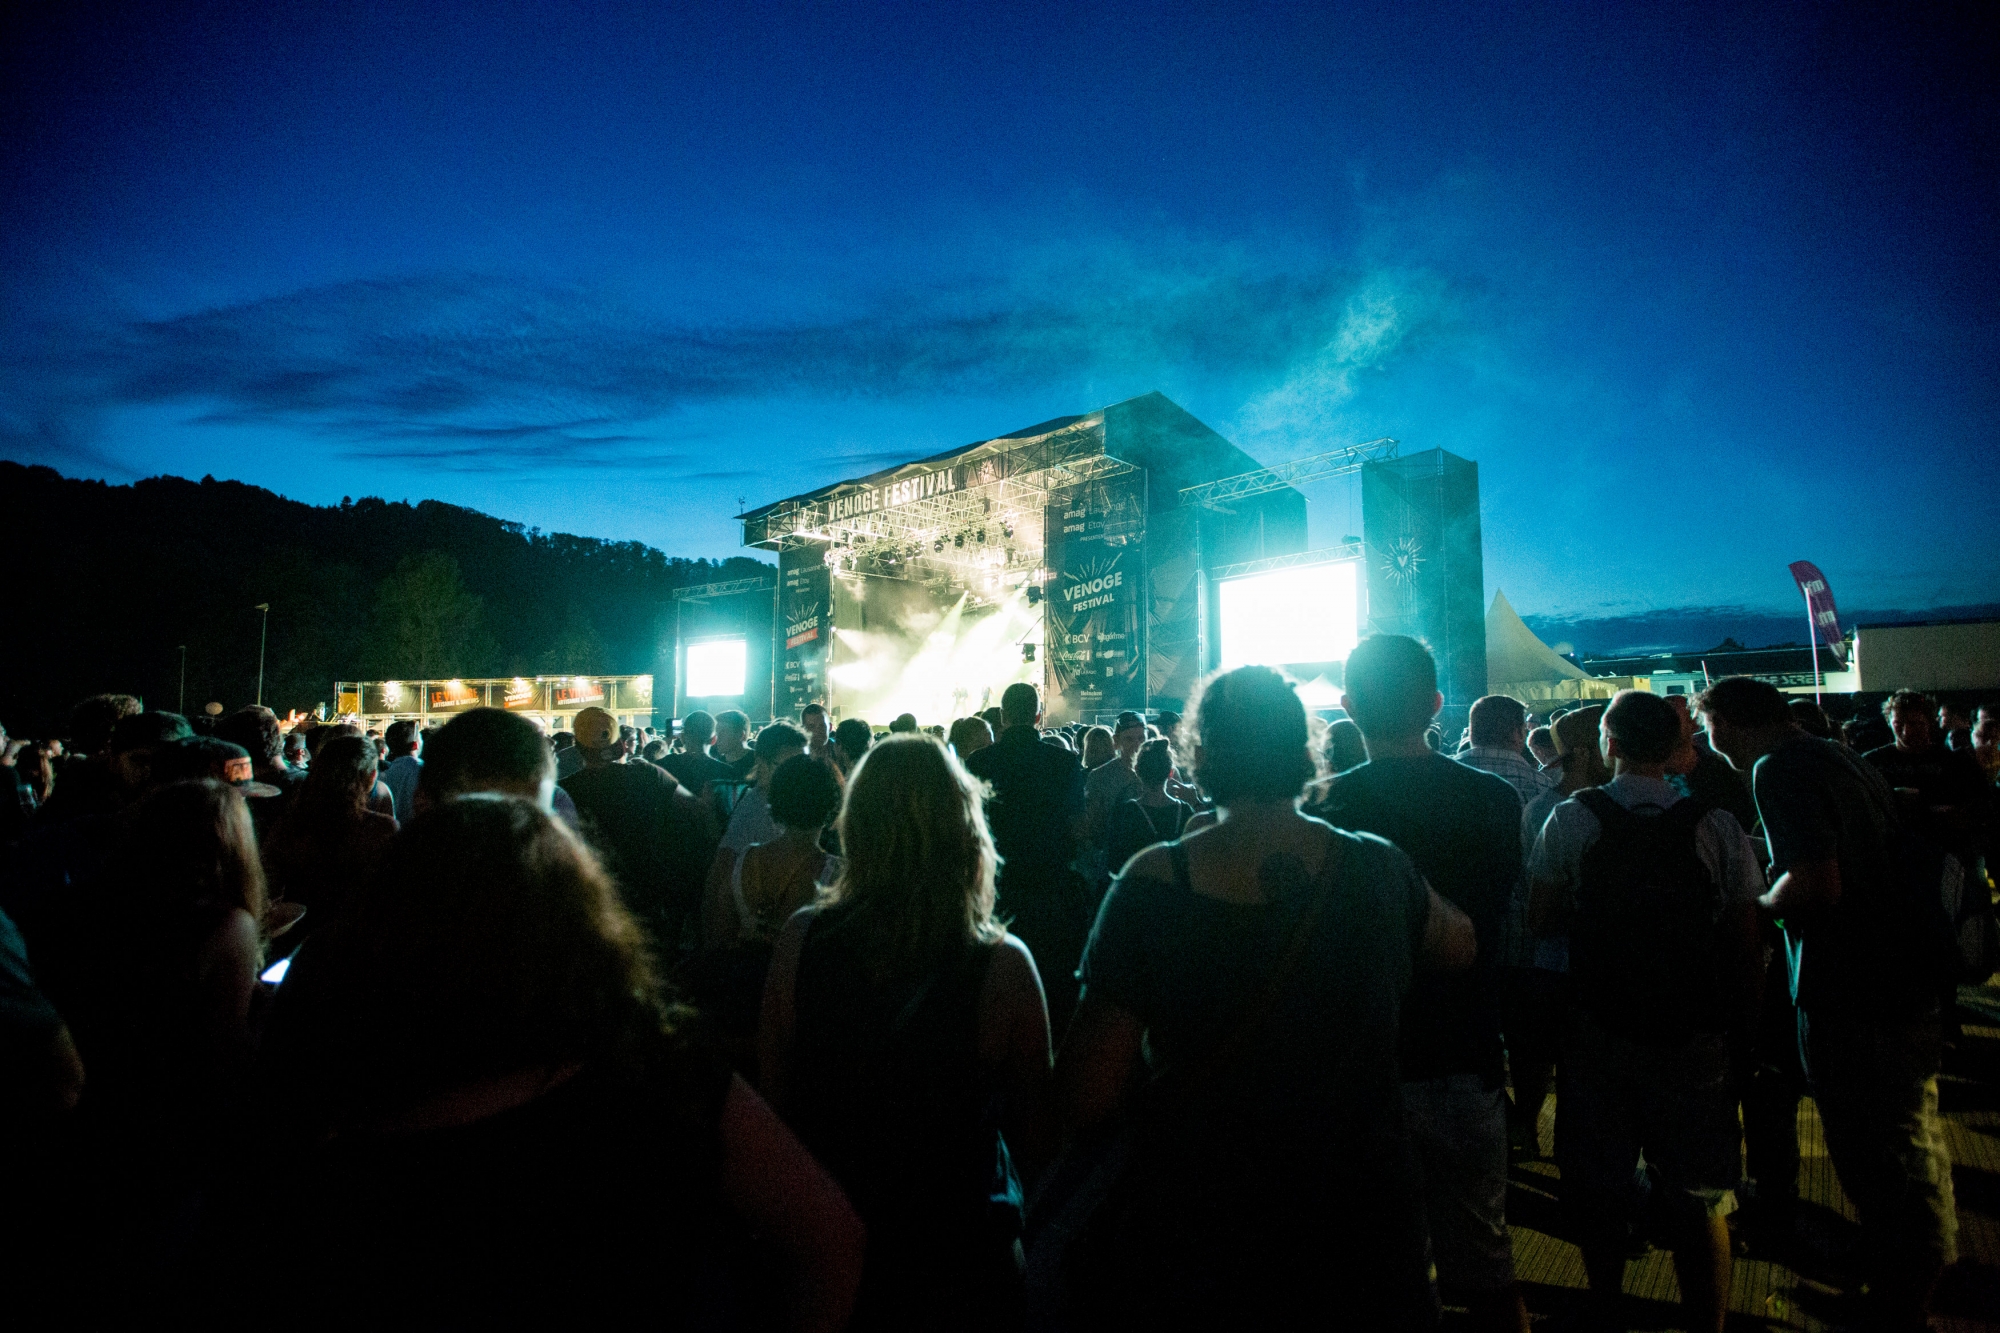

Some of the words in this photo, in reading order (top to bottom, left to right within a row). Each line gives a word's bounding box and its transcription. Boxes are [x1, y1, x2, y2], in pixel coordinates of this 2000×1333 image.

[827, 488, 880, 522] VENOGE
[884, 468, 956, 507] FESTIVAL
[1063, 507, 1086, 520] amag
[1063, 522, 1085, 534] amag
[1063, 571, 1123, 602] VENOGE
[1073, 593, 1115, 613] FESTIVAL
[786, 616, 818, 637] VENOGE
[1072, 633, 1090, 645] BCV
[431, 691, 443, 704] LE
[442, 687, 478, 702] VIAGE
[556, 688, 568, 701] LE
